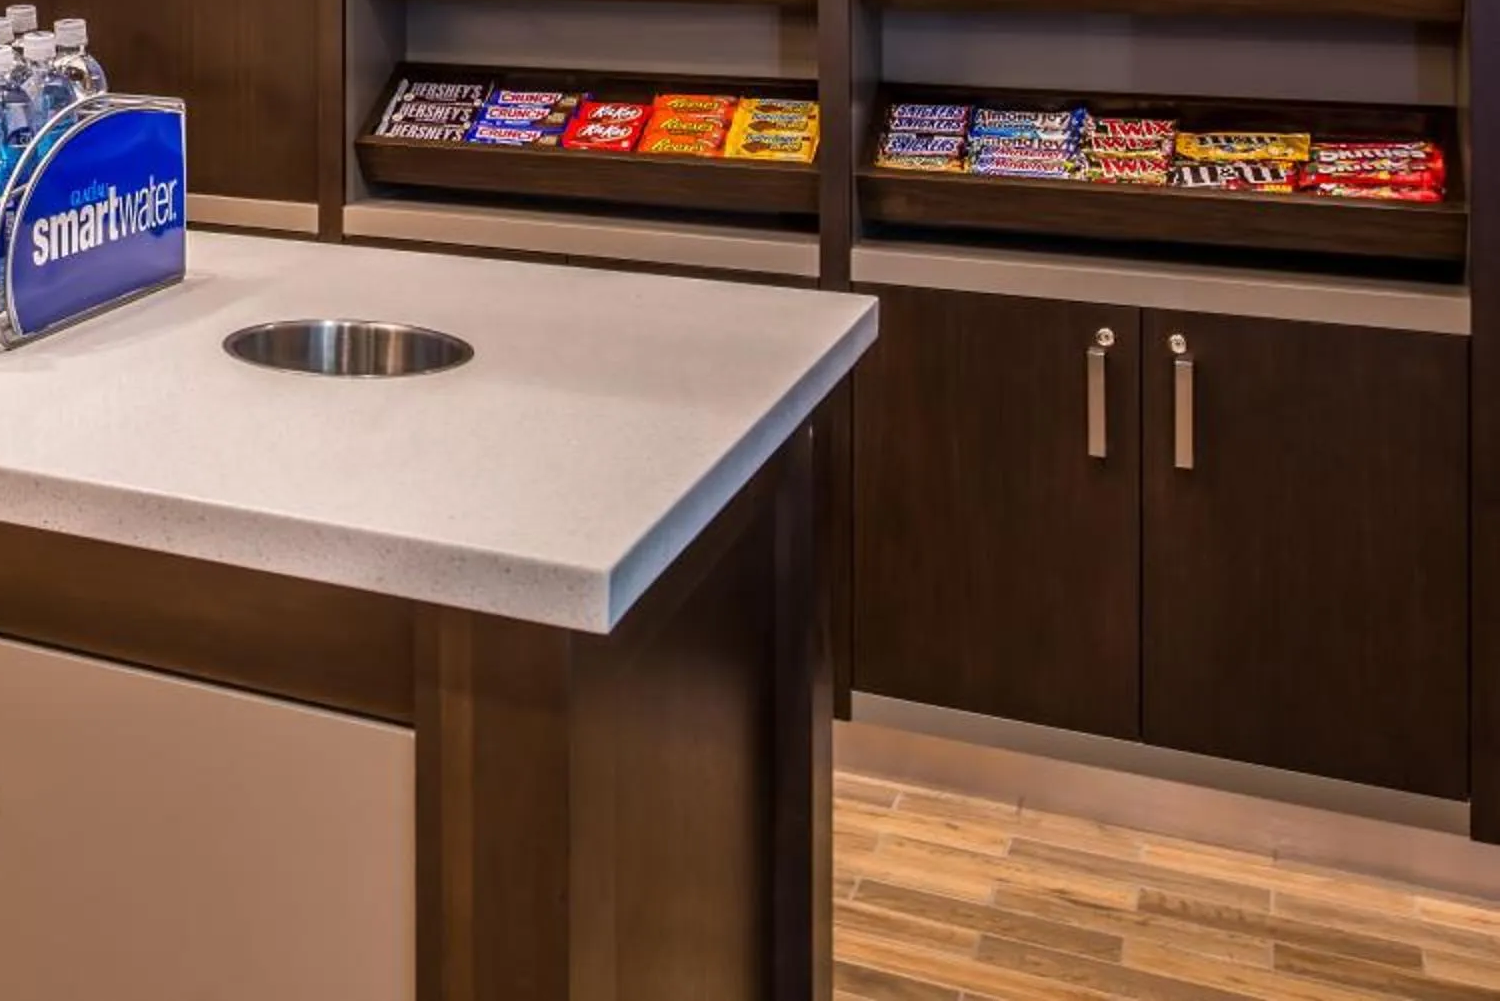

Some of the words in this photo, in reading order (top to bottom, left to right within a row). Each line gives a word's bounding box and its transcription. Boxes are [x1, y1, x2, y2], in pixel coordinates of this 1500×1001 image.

[400, 102, 472, 122] HERSHEY'S
[488, 106, 550, 120] CRUNCH
[391, 123, 465, 141] HERSHEY'S
